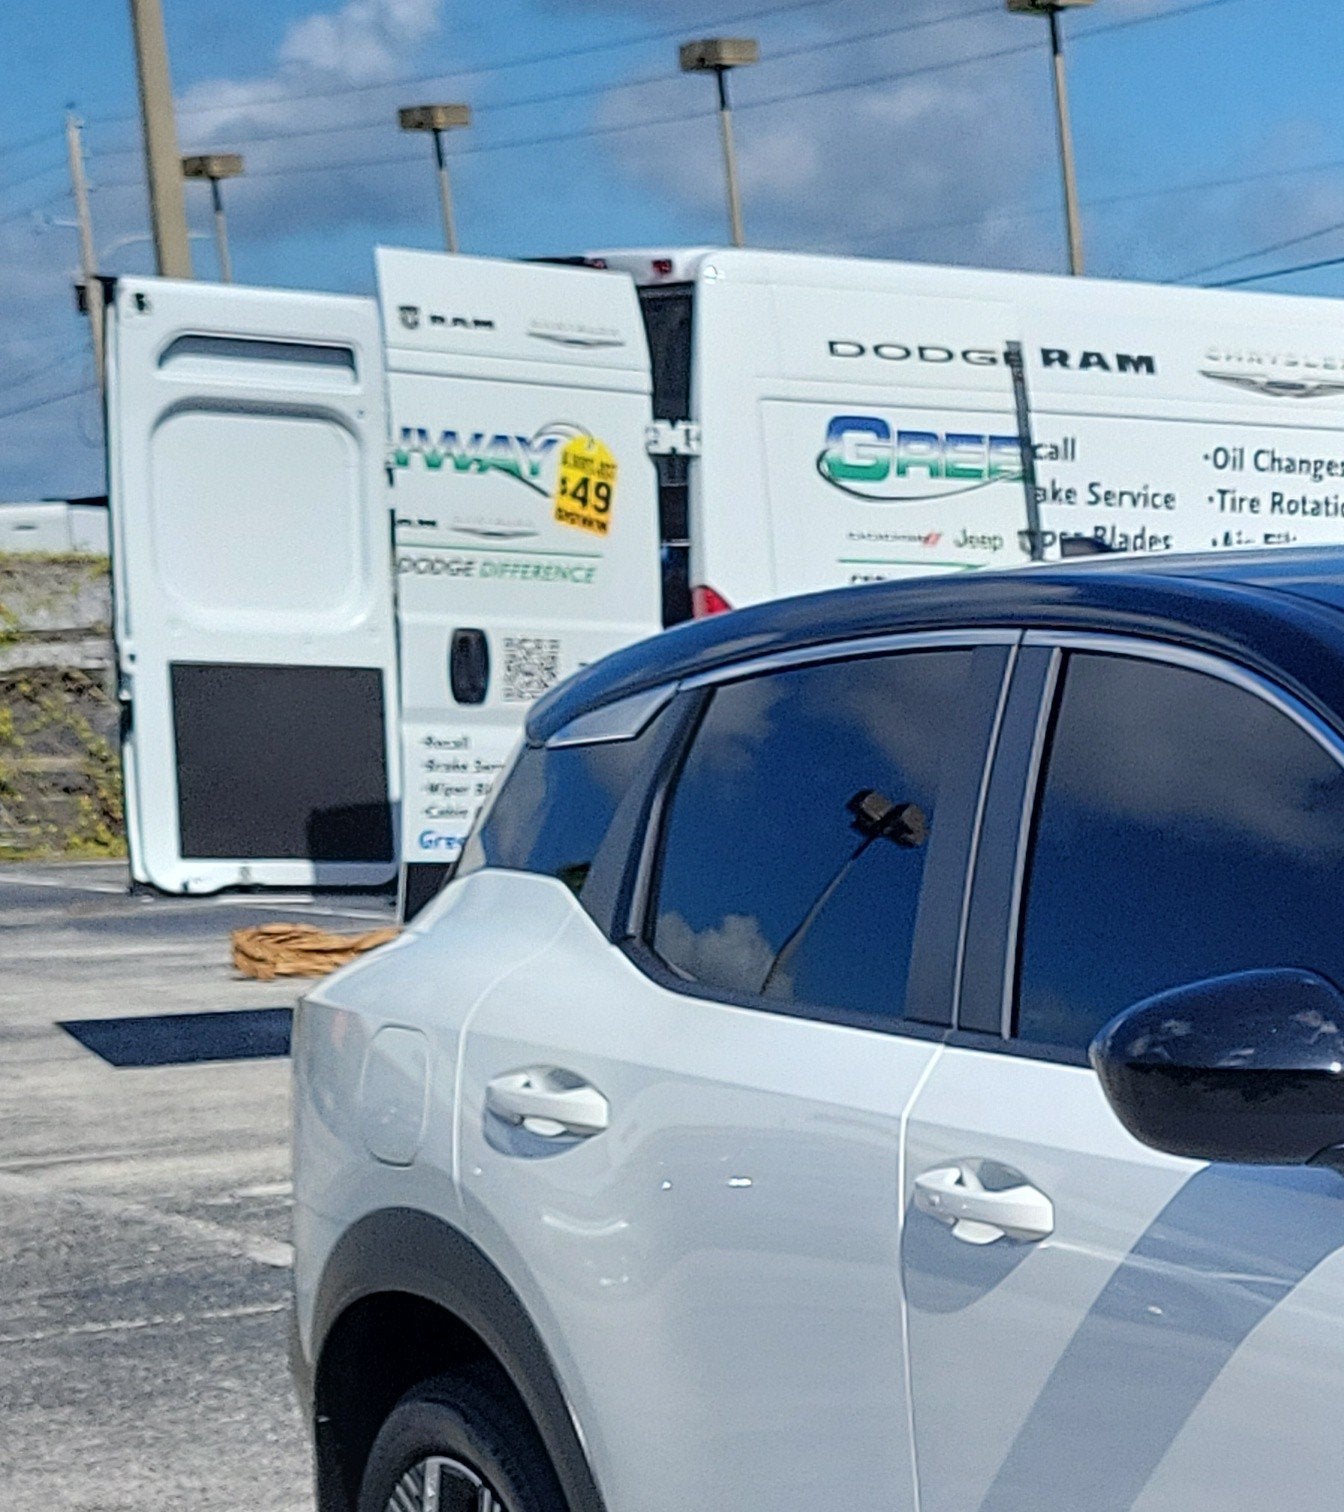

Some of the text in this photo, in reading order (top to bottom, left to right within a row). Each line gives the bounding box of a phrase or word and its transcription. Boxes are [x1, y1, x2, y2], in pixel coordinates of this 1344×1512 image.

[1041, 348, 1157, 376] RAM
[1213, 446, 1244, 471] Oil
[1087, 481, 1176, 510] Service
[1217, 489, 1260, 514] Tire
[397, 556, 596, 584] DODGE DIFFERENCE
